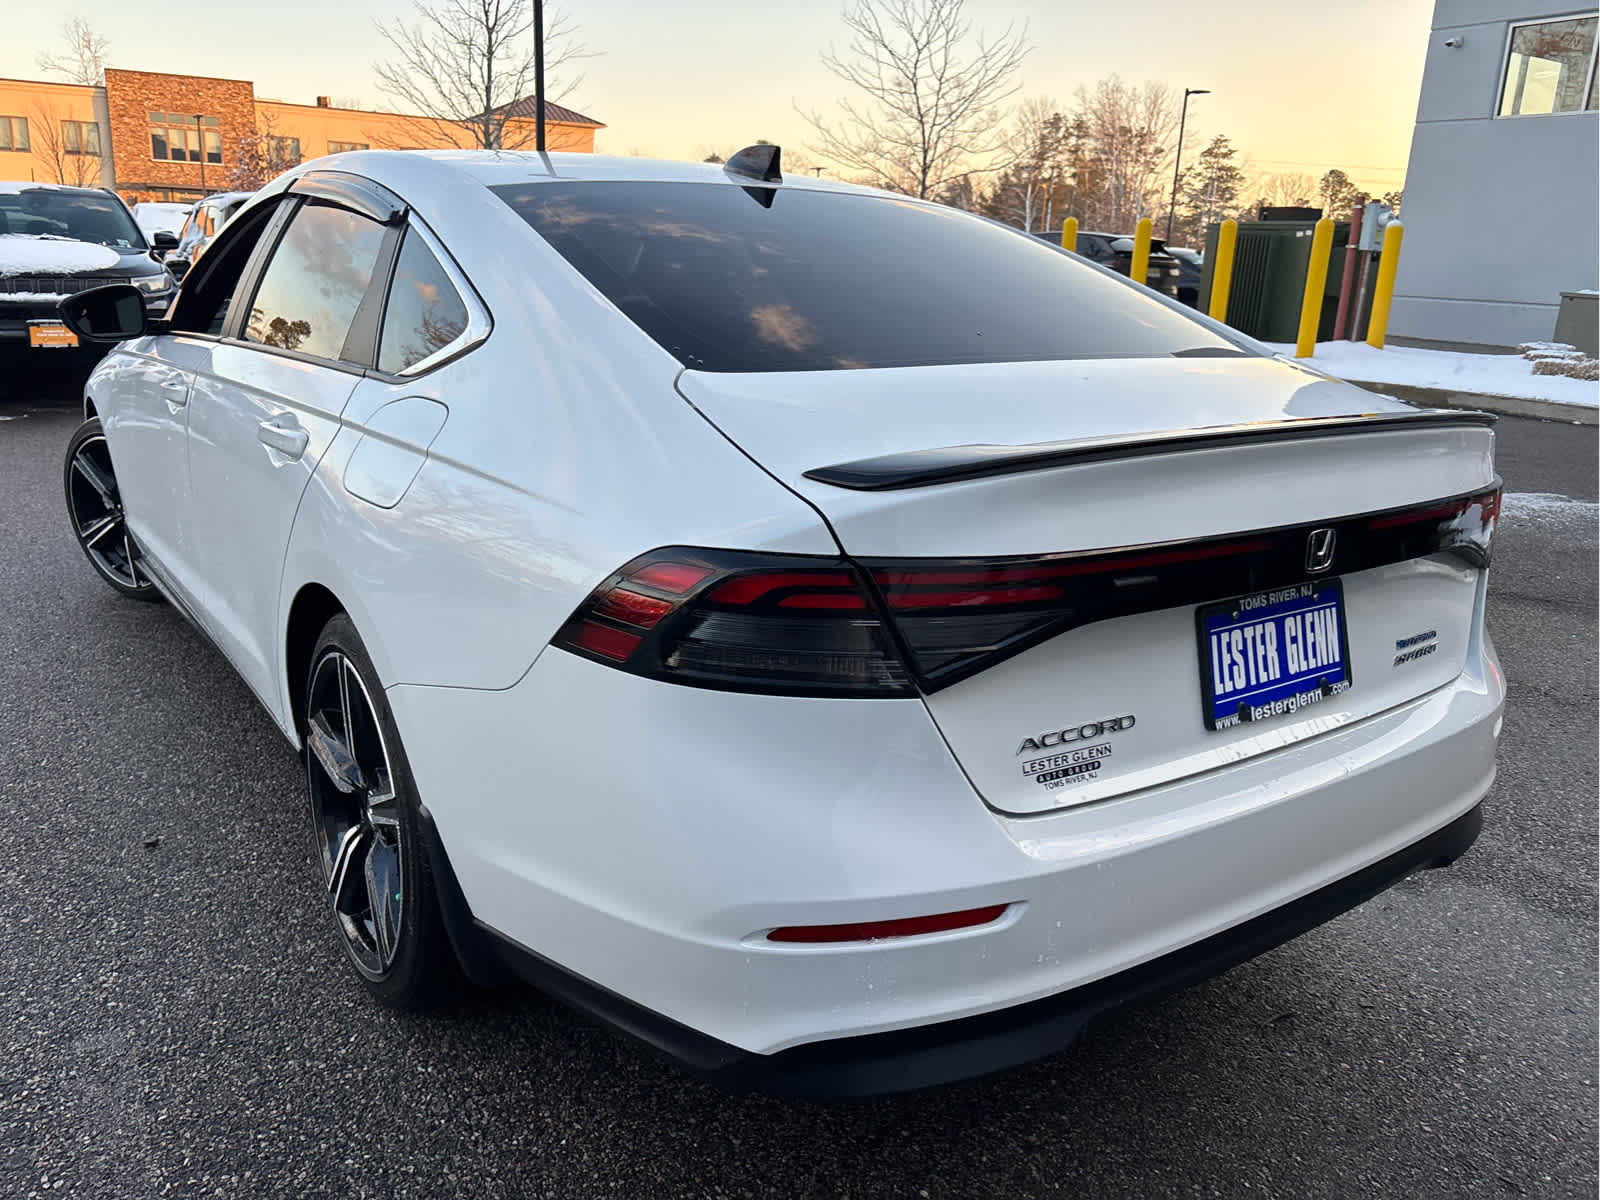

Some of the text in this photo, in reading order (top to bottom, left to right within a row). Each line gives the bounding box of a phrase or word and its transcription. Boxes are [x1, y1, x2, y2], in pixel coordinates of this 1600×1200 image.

[1240, 594, 1268, 612] TOMS
[1301, 584, 1313, 598] NJ
[1211, 607, 1340, 695] LESTER GLENN
[1016, 714, 1136, 756] ACCORD
[1022, 744, 1112, 775] LESTER GLENN
[1038, 761, 1100, 783] AUTO GROUP
[1044, 780, 1065, 791] TOMS
[1089, 771, 1097, 780] NJ
